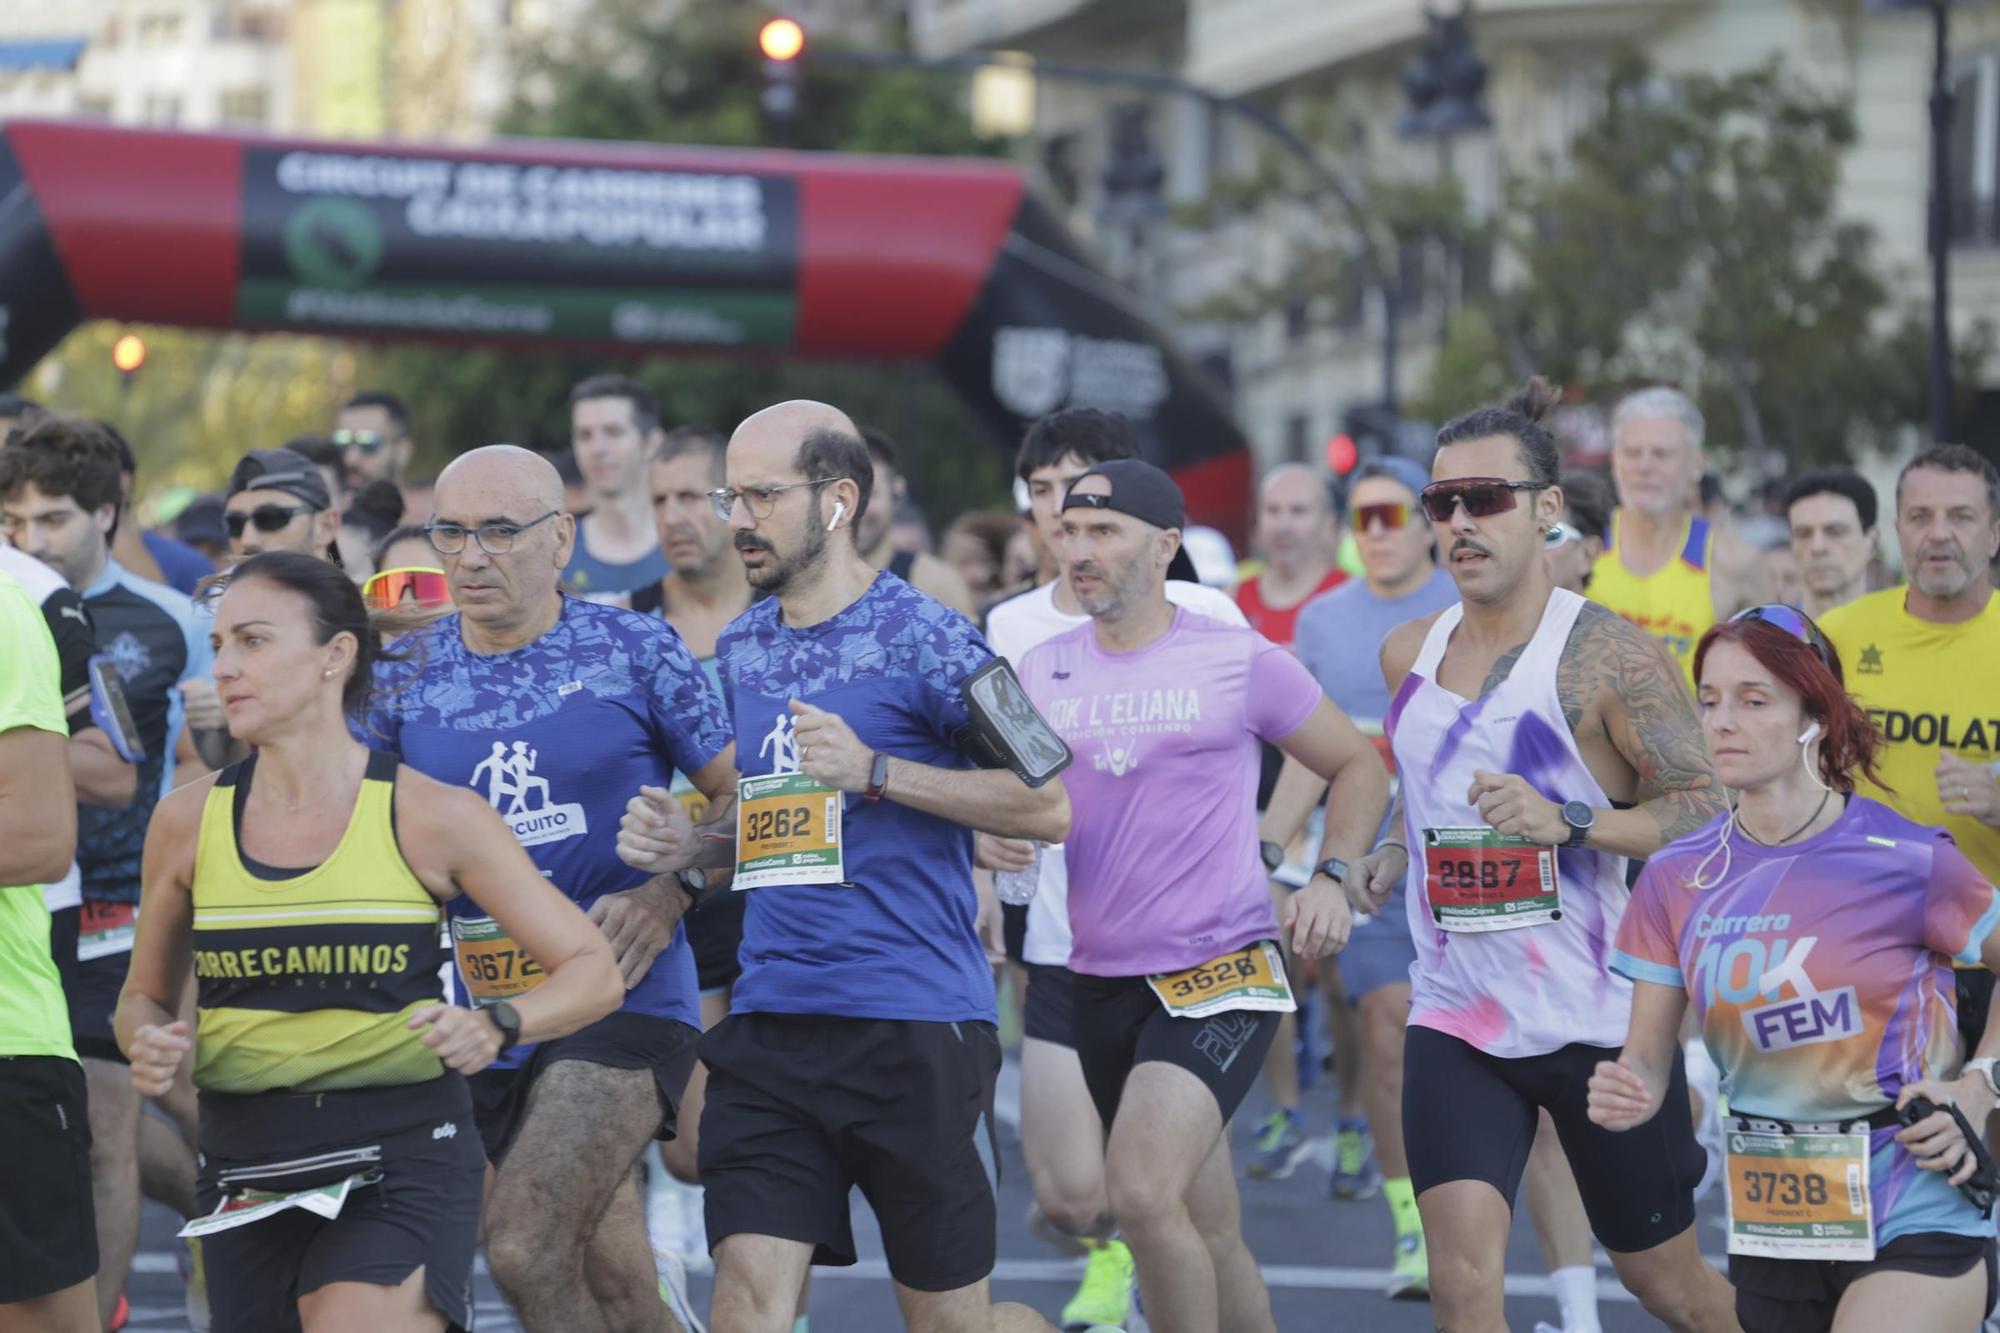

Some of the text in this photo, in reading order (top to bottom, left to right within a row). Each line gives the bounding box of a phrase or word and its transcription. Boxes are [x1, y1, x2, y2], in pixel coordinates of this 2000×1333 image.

[277, 152, 451, 198] CIRCUIT
[455, 163, 519, 203] DE
[746, 806, 812, 842] 3262
[1440, 860, 1521, 888] 2887
[466, 949, 543, 981] 3672
[1696, 936, 1818, 1009] 10K
[1753, 992, 1852, 1048] FEM
[1744, 1170, 1828, 1206] 3738
